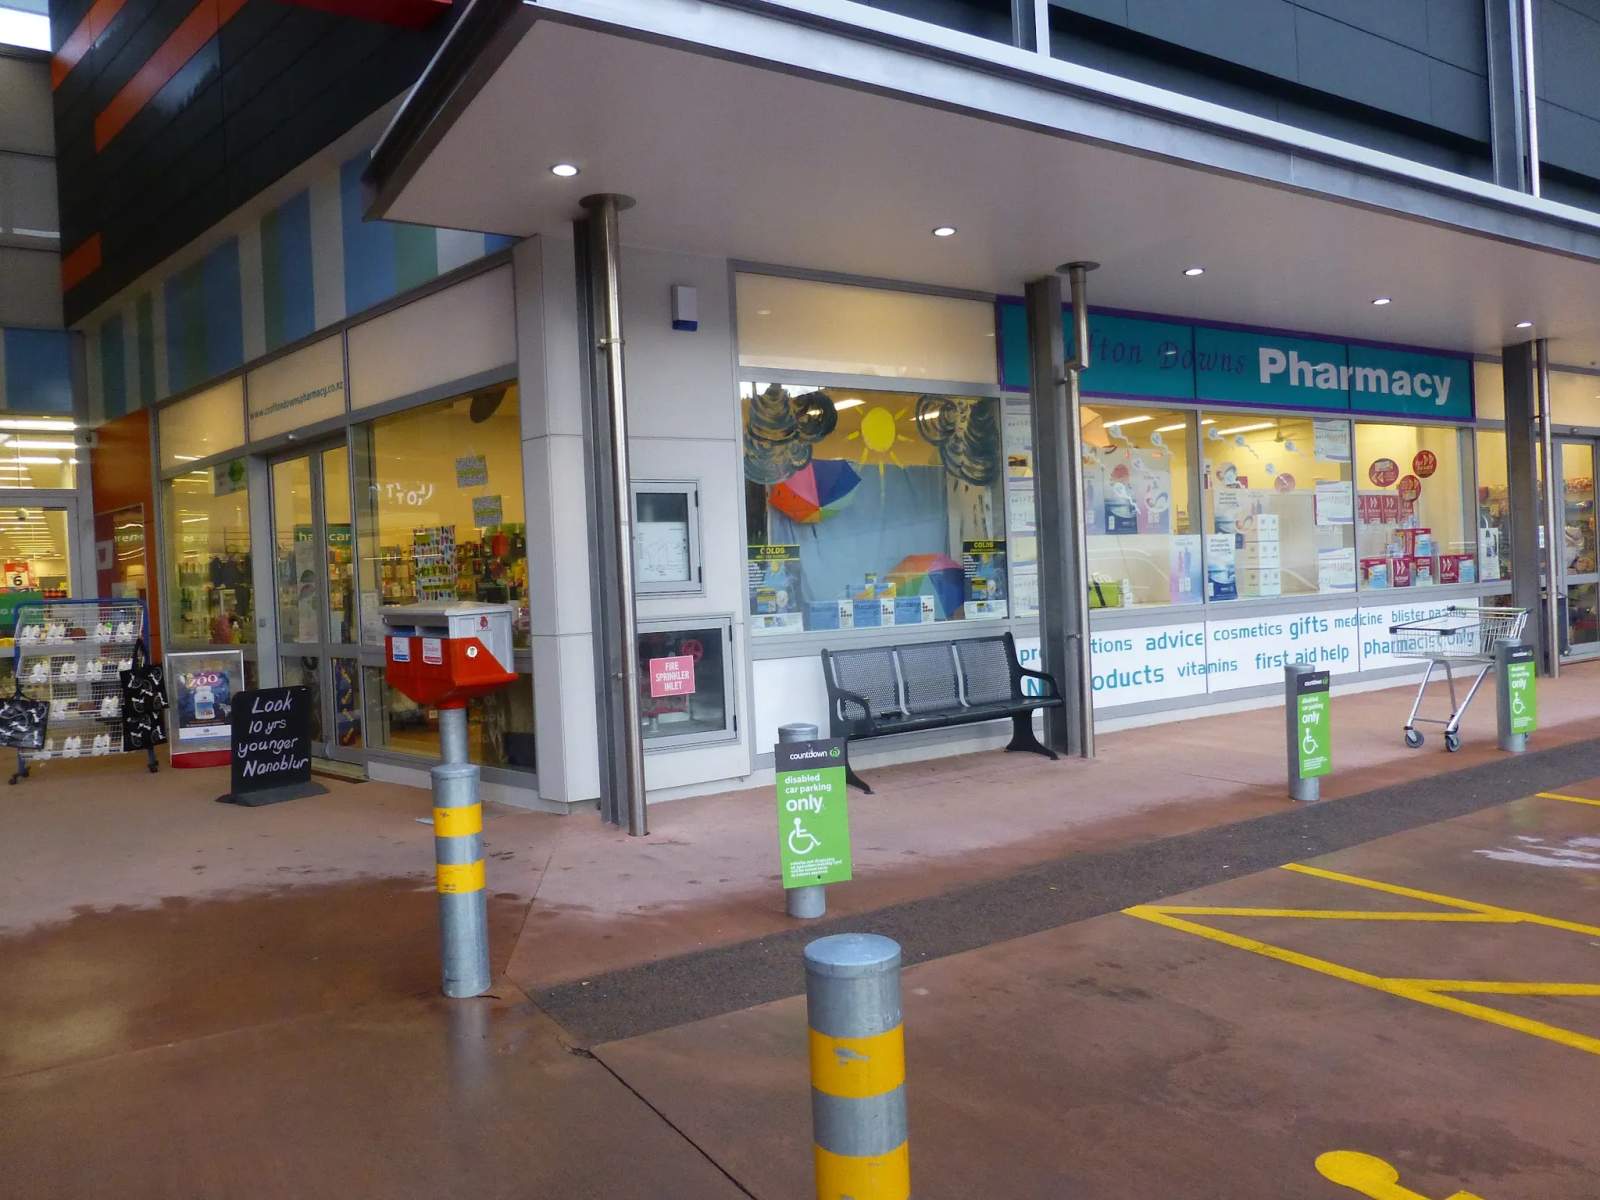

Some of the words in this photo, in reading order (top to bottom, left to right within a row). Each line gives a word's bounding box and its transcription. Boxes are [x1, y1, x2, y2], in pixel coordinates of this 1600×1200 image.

[1159, 341, 1248, 375] Downs
[1258, 347, 1451, 406] Pharmacy
[13, 575, 23, 586] 6
[1145, 630, 1203, 651] advice
[1213, 623, 1283, 641] cosmetics
[1290, 616, 1328, 640] gifts
[1334, 612, 1383, 628] medicine
[1392, 609, 1425, 623] blister
[665, 661, 679, 671] FIRE
[1091, 665, 1164, 691] oducts
[1177, 658, 1238, 677] vitamins
[1256, 650, 1289, 669] first
[1295, 647, 1317, 664] aid
[1321, 643, 1349, 662] help
[1364, 633, 1443, 657] pharmacist
[655, 669, 689, 682] SPRINKLER
[664, 680, 682, 691] INLET
[1512, 678, 1526, 690] only
[252, 690, 292, 714] Look
[1302, 711, 1320, 725] only
[249, 720, 262, 735] 10
[265, 719, 287, 735] yrs
[238, 737, 298, 758] younger
[790, 749, 827, 760] countdown
[243, 754, 308, 777] Nanoblur
[785, 773, 820, 784] disabled
[785, 785, 798, 794] car
[799, 783, 832, 795] parking
[786, 795, 823, 813] only
